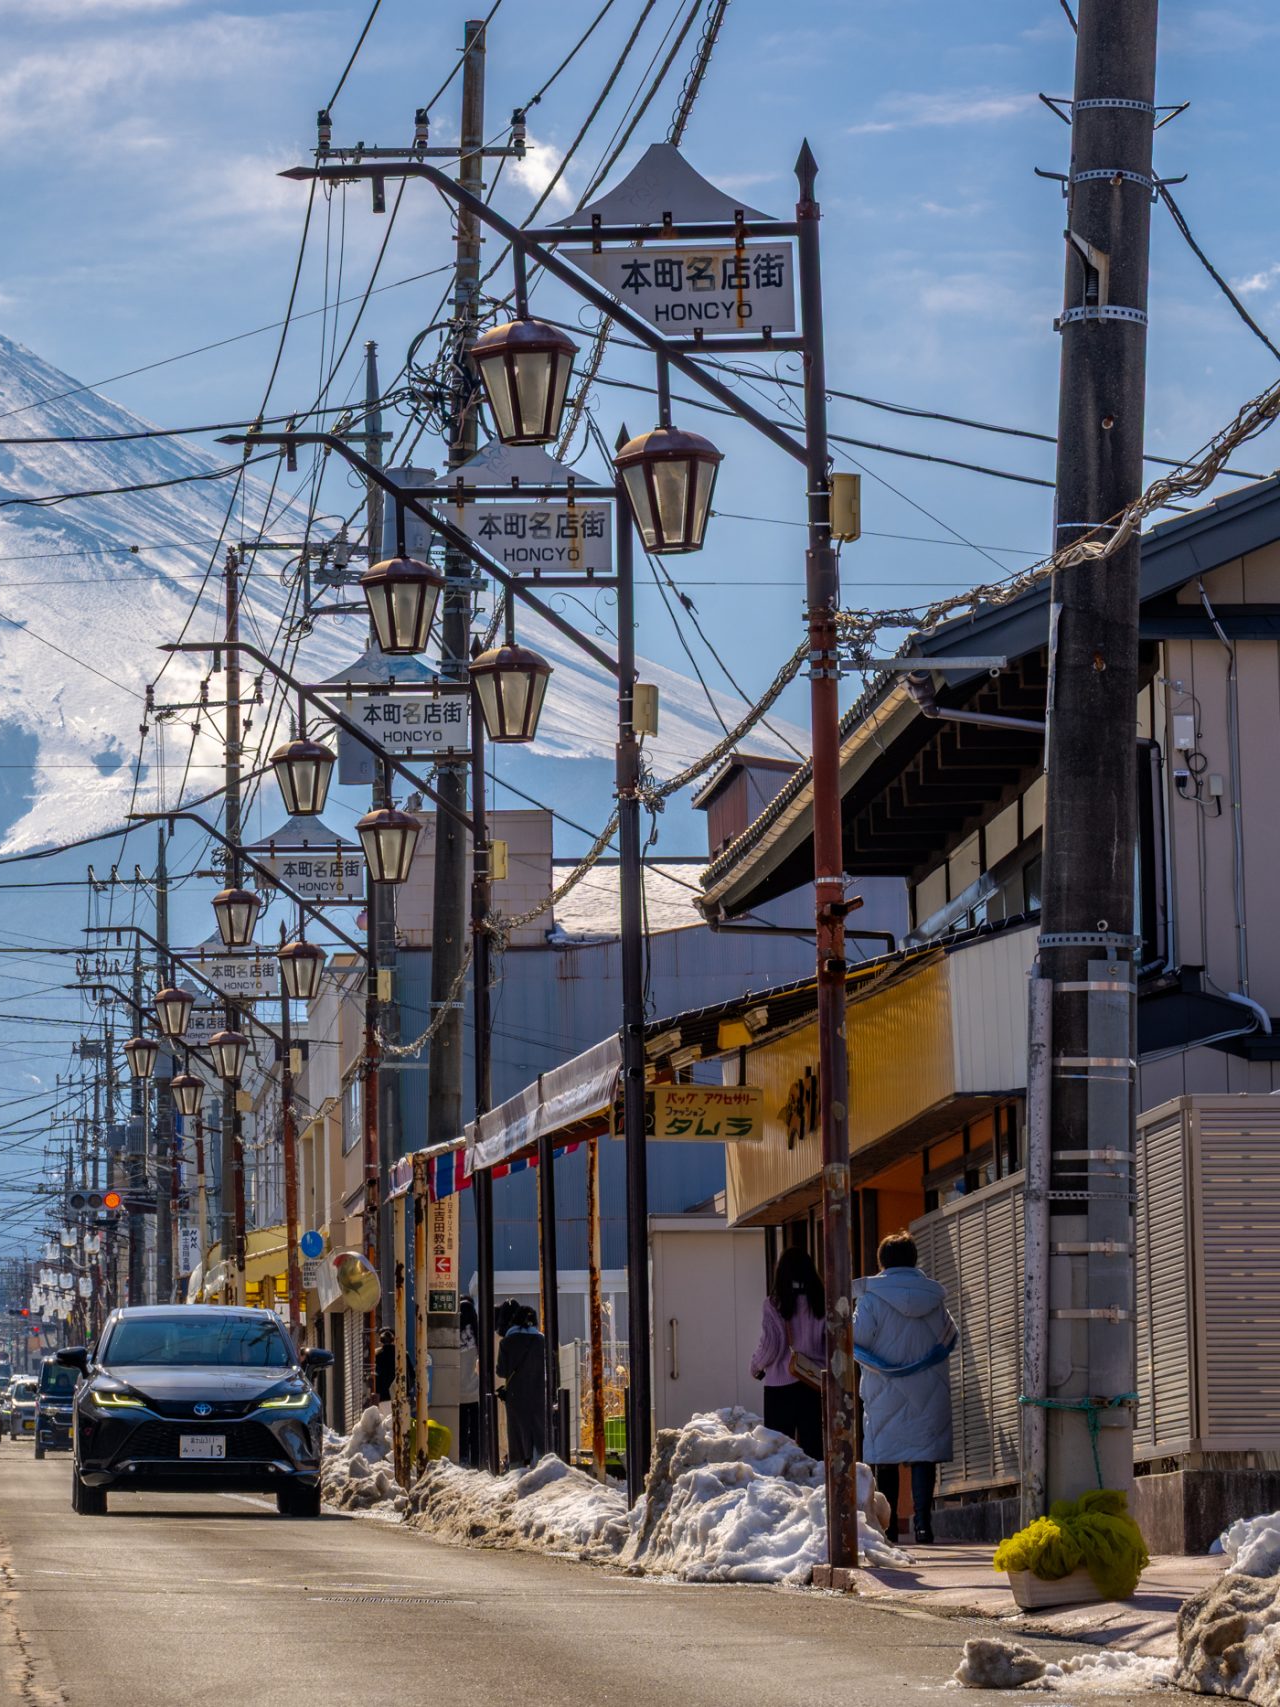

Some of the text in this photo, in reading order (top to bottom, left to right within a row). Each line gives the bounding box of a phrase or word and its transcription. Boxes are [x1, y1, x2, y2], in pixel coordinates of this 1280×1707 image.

[621, 252, 785, 294] 本町名店街
[478, 511, 605, 540] 本町名店街
[363, 703, 462, 725] 本町名店街
[283, 860, 360, 878] 本町名店街
[212, 963, 274, 979] 本町名店街
[666, 1093, 758, 1105] バッグ アクセサリー
[665, 1107, 706, 1117] ファッション
[665, 1117, 753, 1136] タムラ
